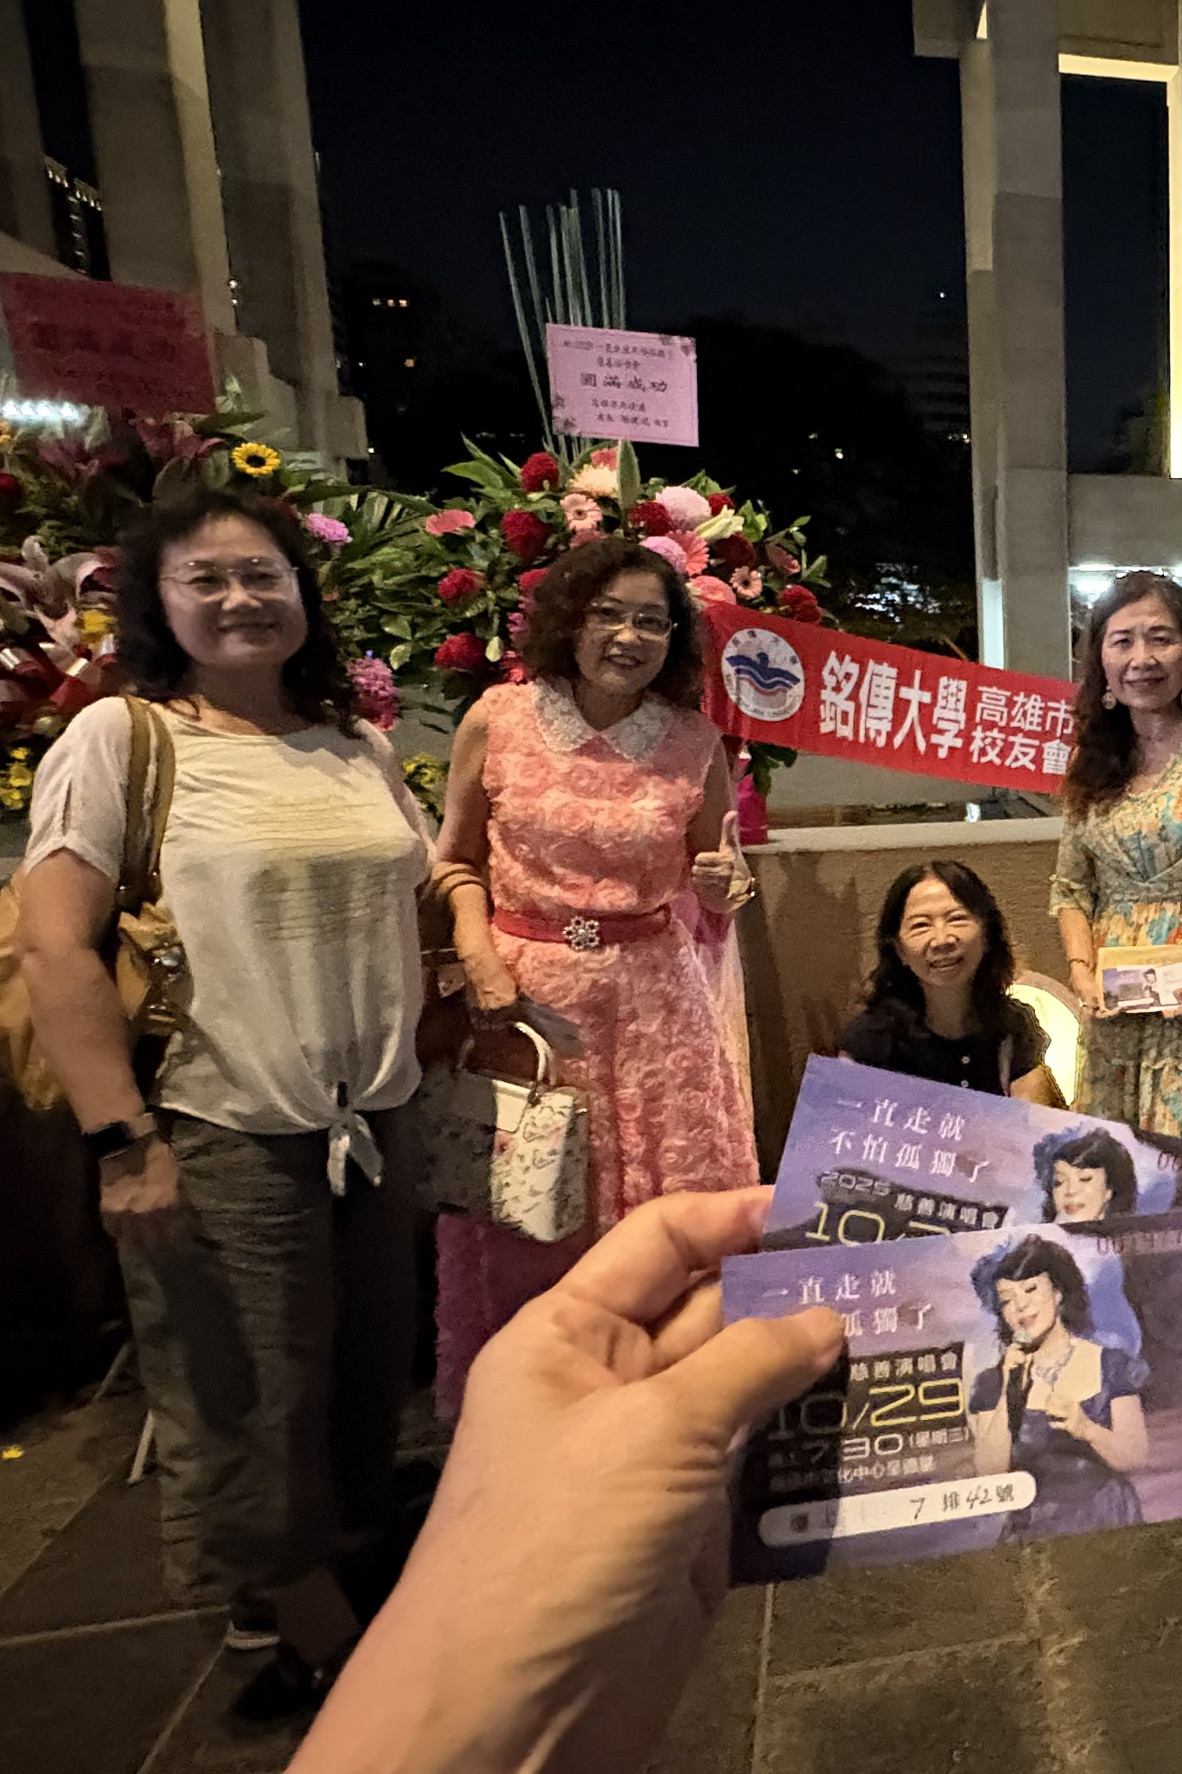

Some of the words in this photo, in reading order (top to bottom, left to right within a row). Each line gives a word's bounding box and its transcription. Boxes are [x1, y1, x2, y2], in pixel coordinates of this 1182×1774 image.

[820, 651, 968, 759] 銘傳大學
[975, 686, 1074, 738] 高雄市
[970, 728, 1072, 775] 校友會
[836, 1096, 966, 1142] 一直走就
[828, 1129, 992, 1184] 不怕孤獨了
[821, 1171, 892, 1197] 2025
[761, 1266, 897, 1304] 一直走就
